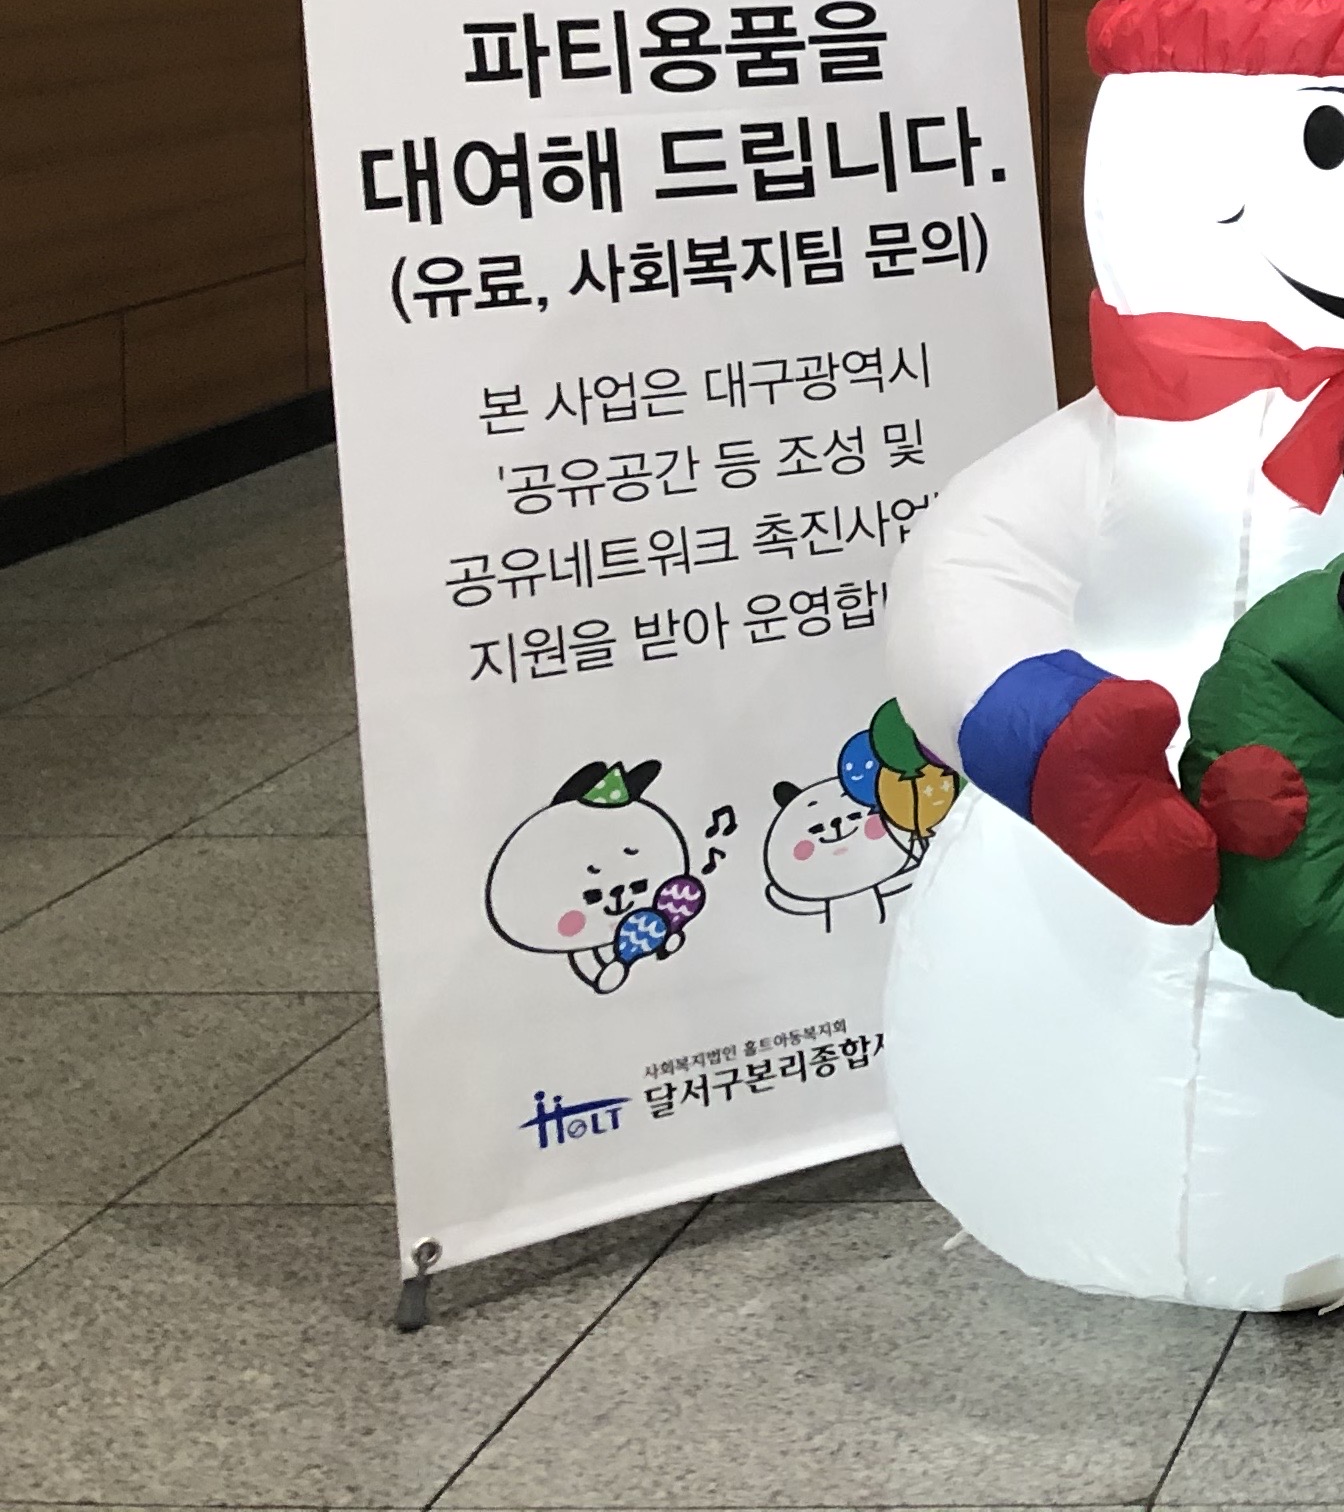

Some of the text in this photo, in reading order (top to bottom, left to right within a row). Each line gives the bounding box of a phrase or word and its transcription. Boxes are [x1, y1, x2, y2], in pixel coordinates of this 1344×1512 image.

[463, 0, 888, 99] 파티용품을
[360, 106, 1006, 226] 대여해 드립니다.
[391, 212, 990, 324] (유료, 사회복지팀 문의)
[479, 342, 931, 436] 본 사업은 대구광역시
[497, 419, 926, 515] '공유공간 등 조성 및
[445, 525, 739, 608] 공유네트워크
[469, 579, 888, 684] 지원을 받아 운영합
[644, 1018, 847, 1080] 사회복지법인 홀트아동복지회
